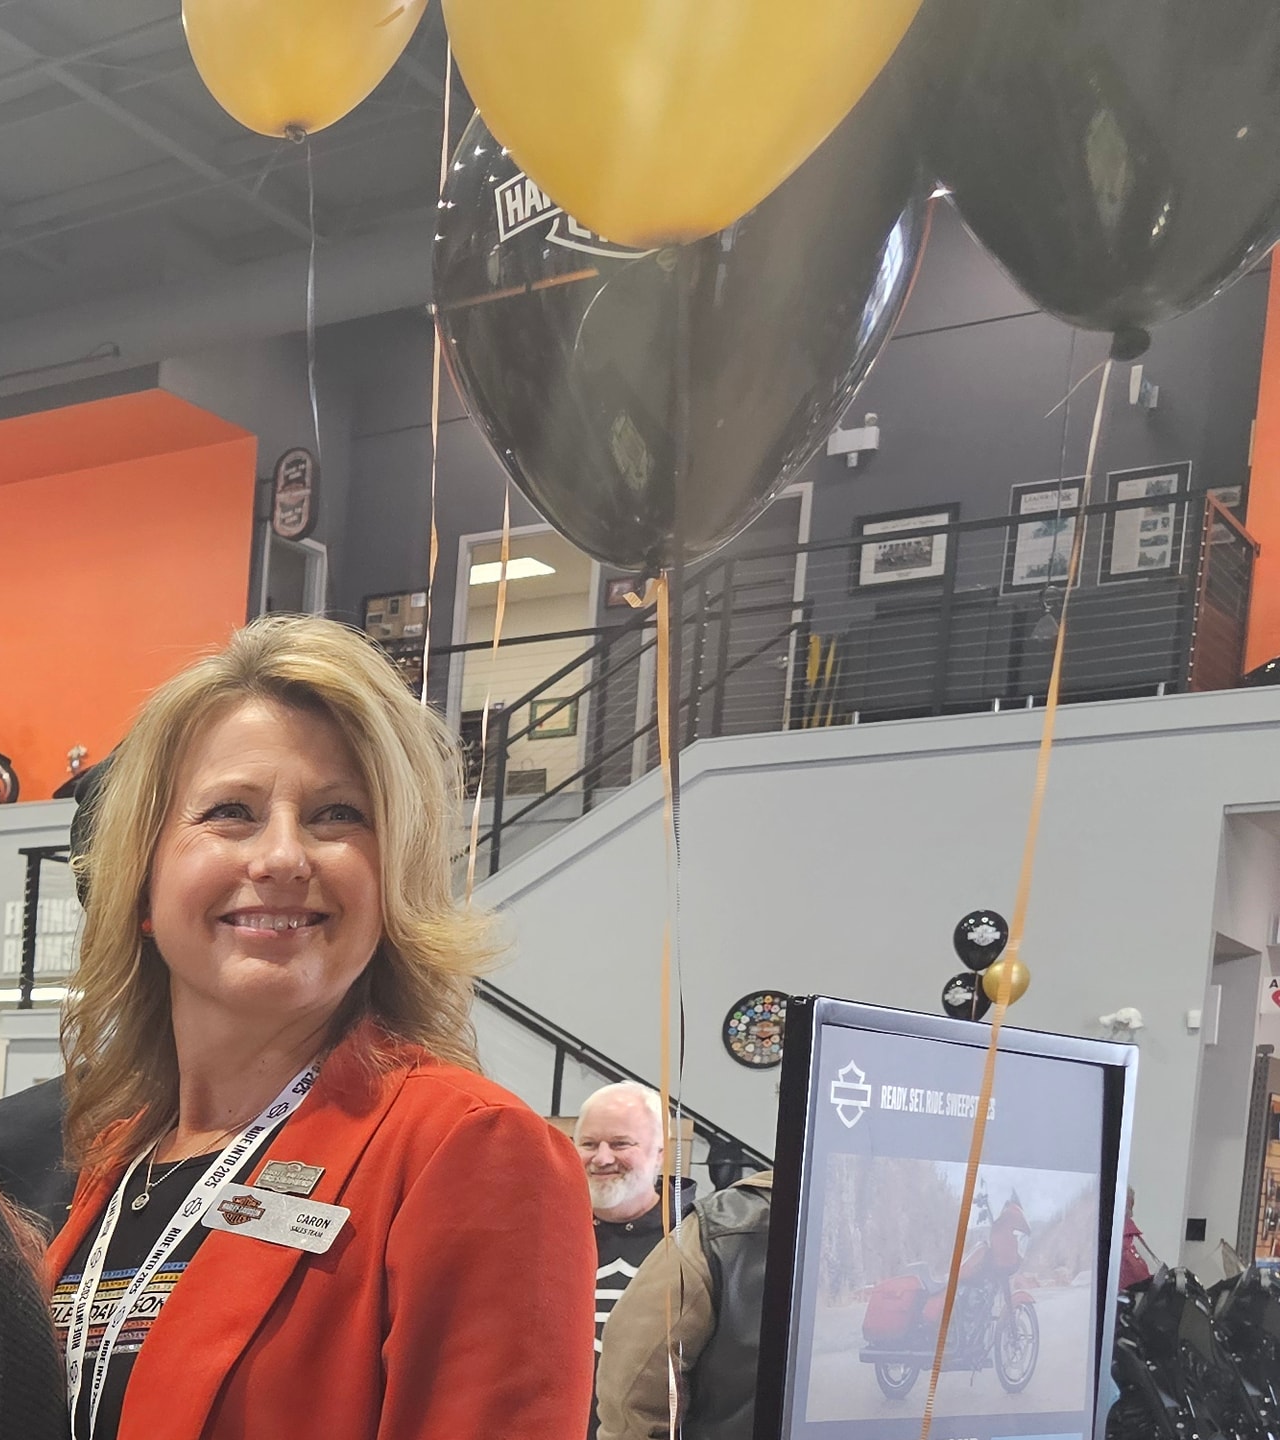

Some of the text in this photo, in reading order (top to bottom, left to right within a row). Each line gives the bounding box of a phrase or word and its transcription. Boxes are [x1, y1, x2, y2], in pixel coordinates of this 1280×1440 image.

[292, 1071, 316, 1095] 2025
[880, 1085, 996, 1120] READY. SET. RIDE. SWEEPSTES
[204, 1125, 266, 1189] RIDE INTO 2025
[290, 1226, 323, 1238] SALES TEAM
[296, 1213, 331, 1229] CARON
[128, 1227, 182, 1295] RIDE INTO 2025
[72, 1278, 95, 1350] RIDE INTO 2025
[101, 1340, 110, 1363] RIDE
[94, 1365, 105, 1390] INTO
